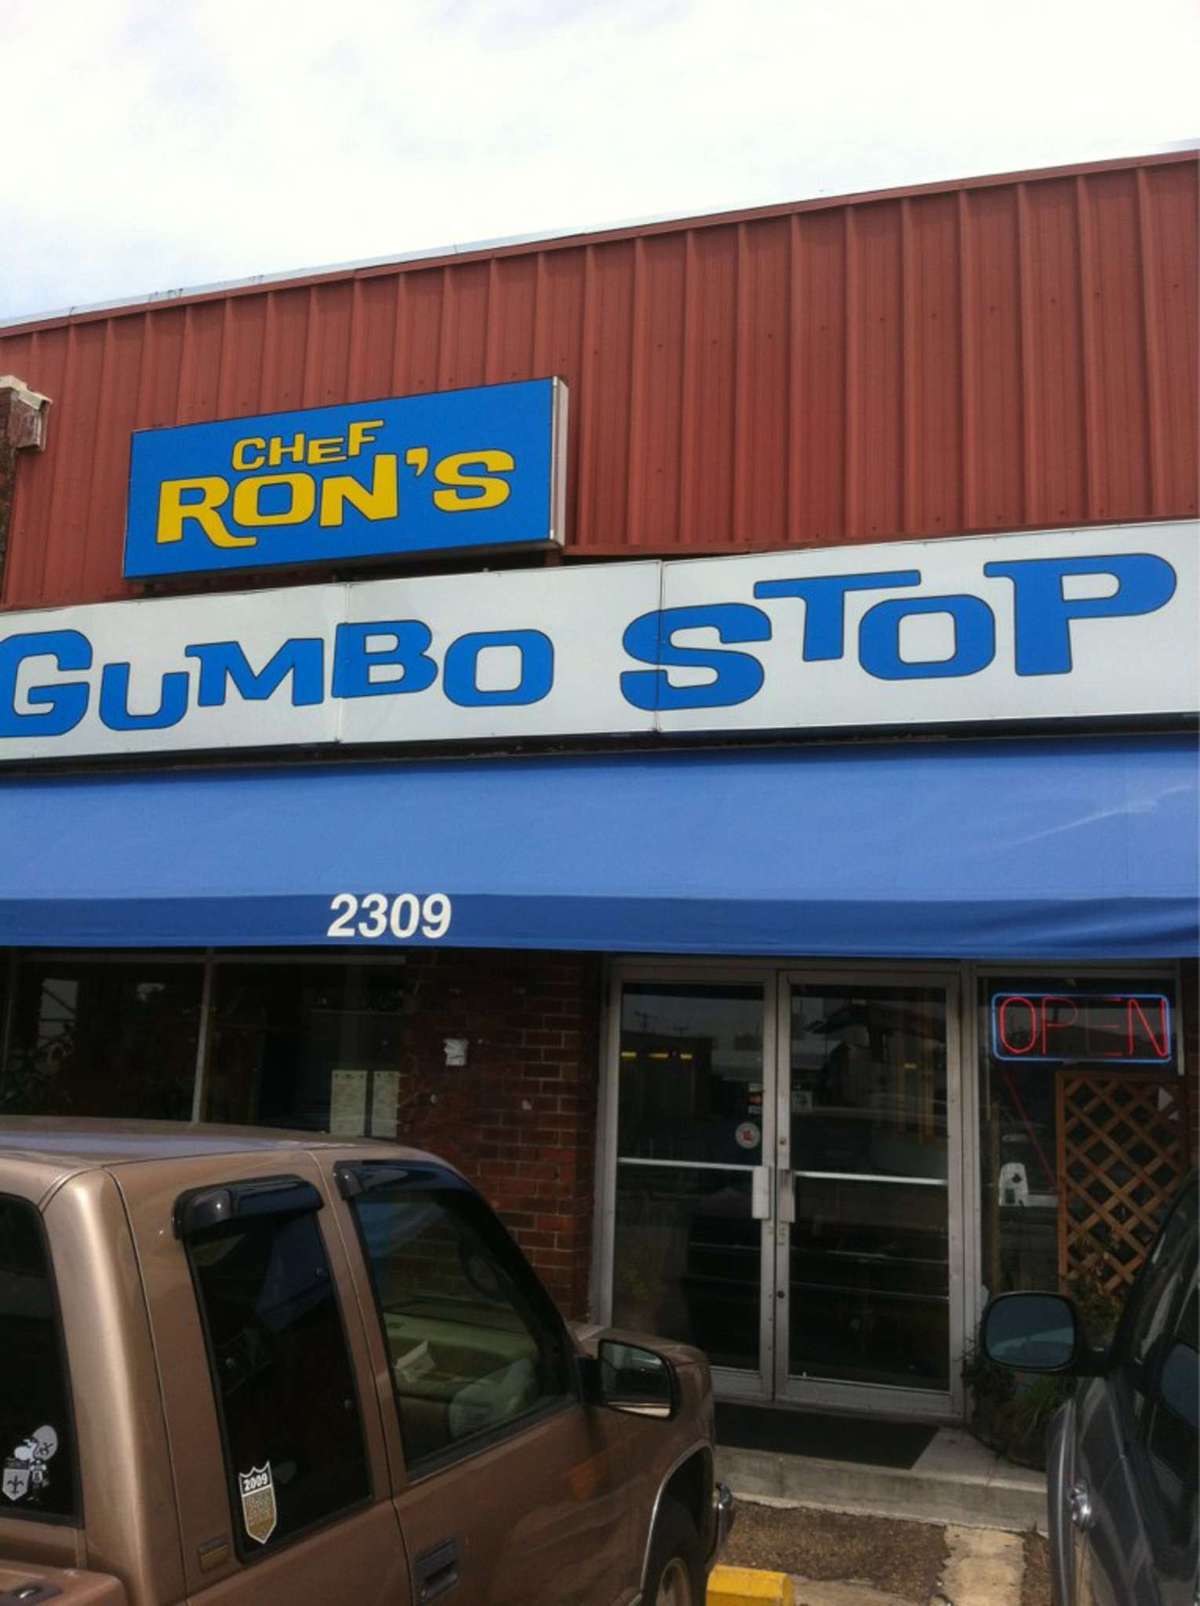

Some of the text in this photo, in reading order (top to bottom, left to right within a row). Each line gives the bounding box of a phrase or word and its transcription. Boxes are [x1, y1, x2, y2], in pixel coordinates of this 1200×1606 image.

[232, 419, 384, 472] CHEF
[155, 447, 516, 548] RON'S
[0, 553, 1178, 737] GUMBO STOP
[326, 893, 452, 939] 2309
[999, 996, 1168, 1057] OPEN
[243, 1473, 268, 1491] 2009
